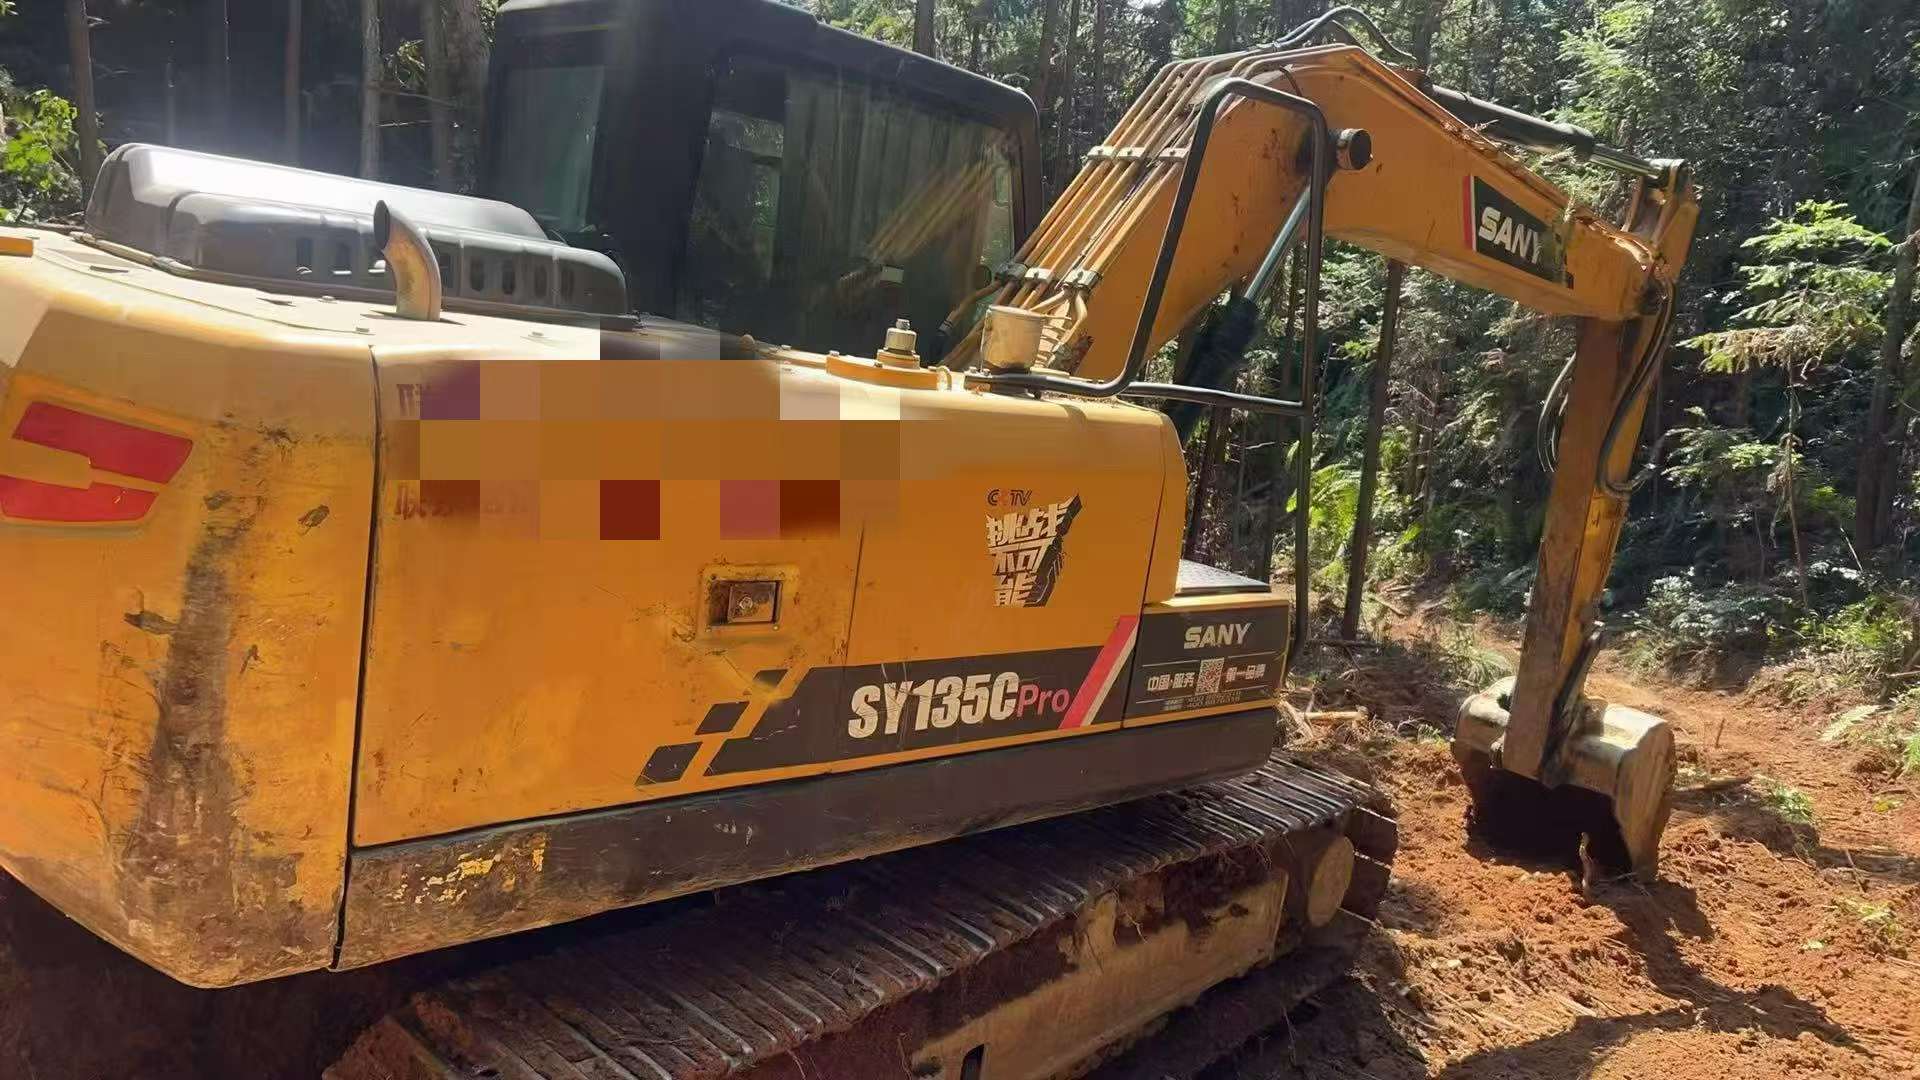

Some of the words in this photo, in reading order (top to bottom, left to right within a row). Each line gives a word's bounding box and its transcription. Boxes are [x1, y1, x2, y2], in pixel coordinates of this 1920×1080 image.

[985, 499, 1074, 548] 挑战
[988, 536, 1055, 574] 不可
[993, 572, 1037, 607] 能
[1184, 622, 1253, 649] SANY
[848, 671, 1019, 738] SY135C
[1016, 684, 1071, 718] Pro
